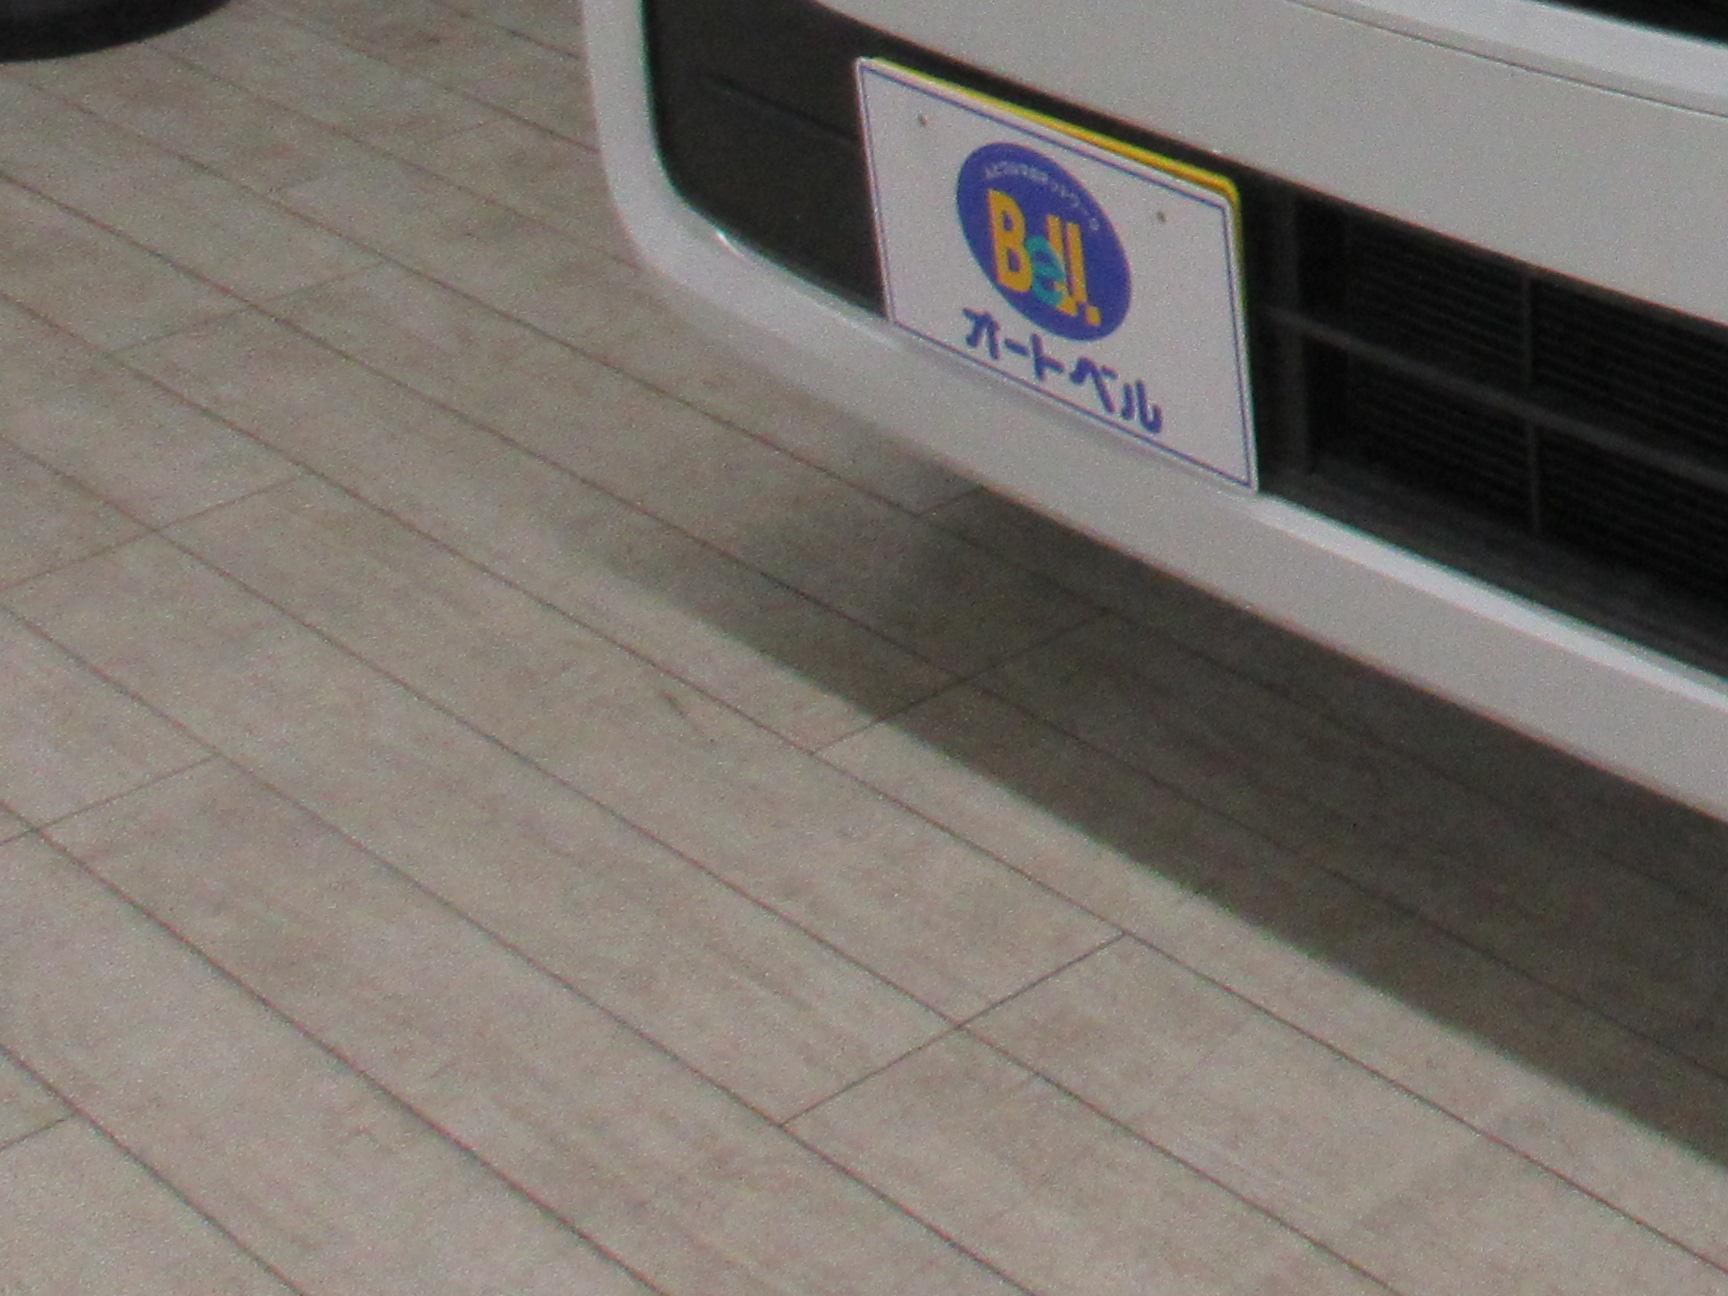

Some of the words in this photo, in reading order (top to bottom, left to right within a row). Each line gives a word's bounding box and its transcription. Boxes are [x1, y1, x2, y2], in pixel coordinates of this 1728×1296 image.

[961, 306, 1163, 436] オートベル
